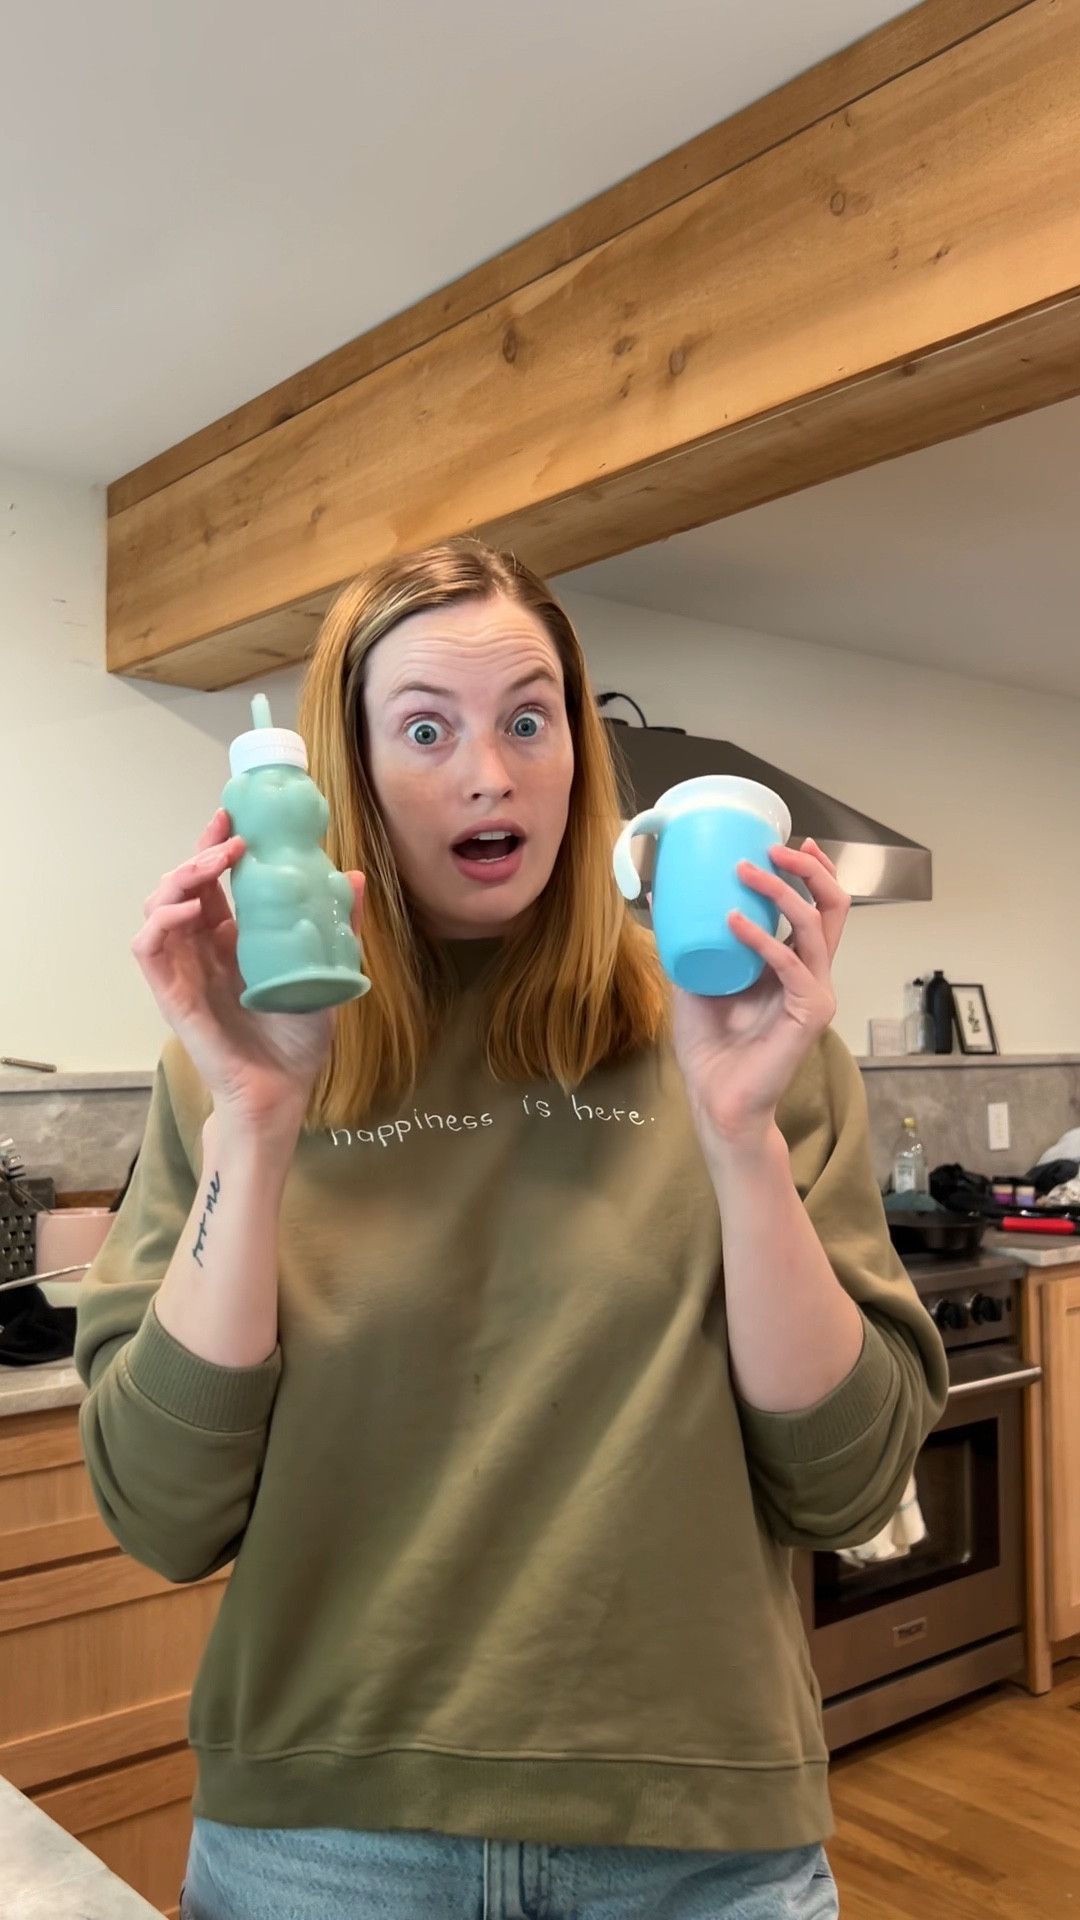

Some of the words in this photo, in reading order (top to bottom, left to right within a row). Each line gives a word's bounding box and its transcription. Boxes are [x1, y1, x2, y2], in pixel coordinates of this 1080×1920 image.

[330, 1108, 494, 1147] happiness
[522, 1094, 551, 1118] is
[571, 1093, 656, 1126] here.
